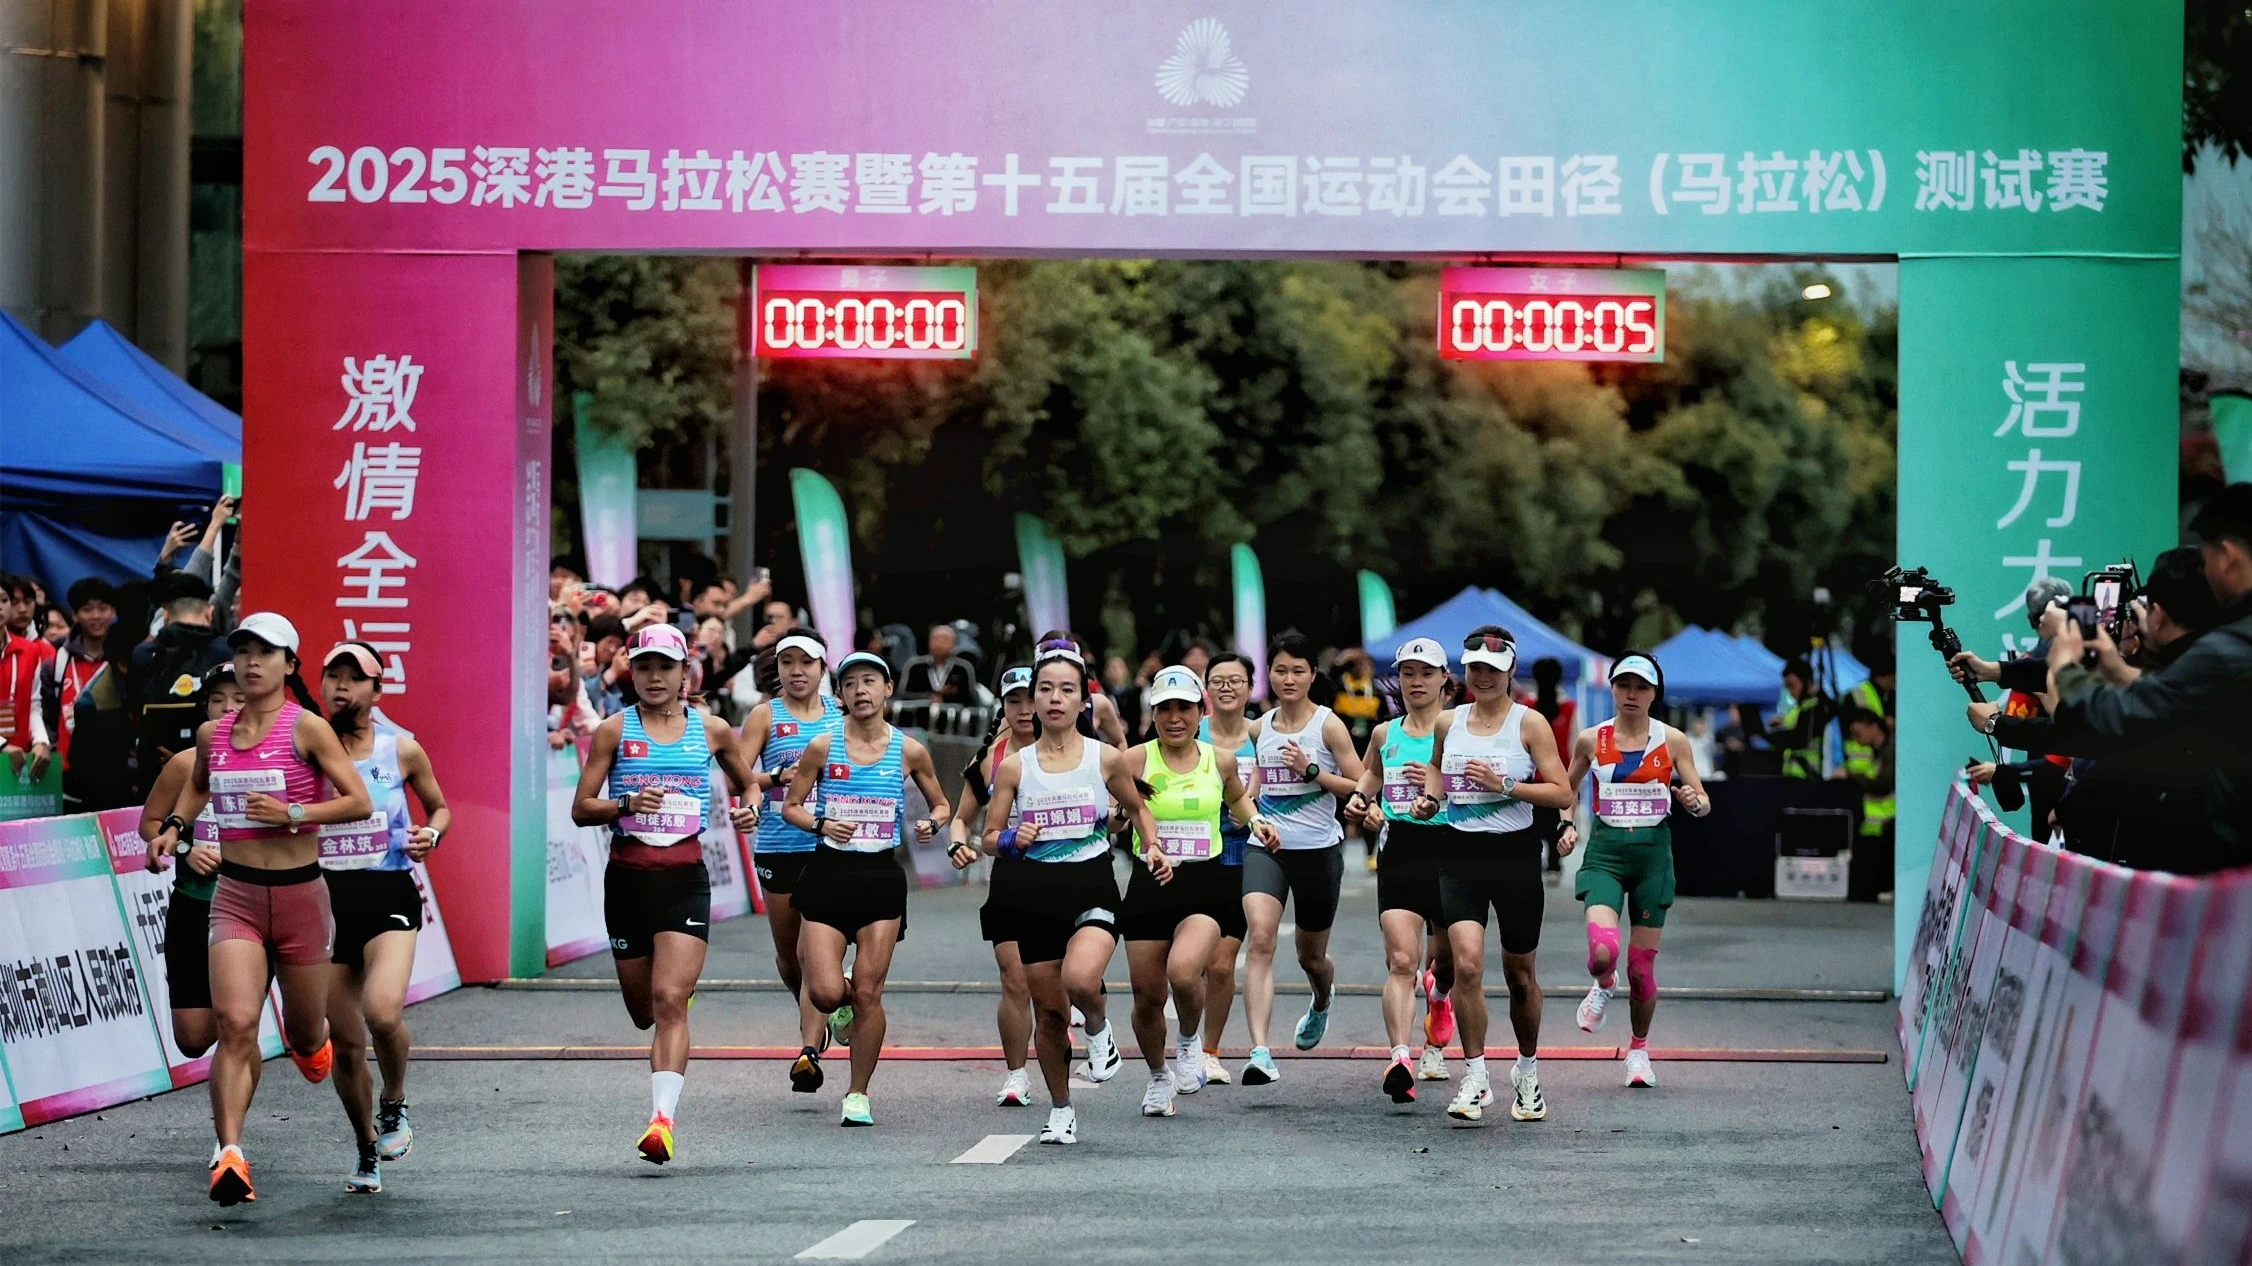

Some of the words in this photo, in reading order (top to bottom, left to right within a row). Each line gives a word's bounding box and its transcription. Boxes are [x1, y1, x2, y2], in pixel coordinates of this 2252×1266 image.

[1529, 272, 1577, 292] 女子
[765, 298, 965, 350] 00:00:00
[1452, 300, 1655, 353] 00:00:05
[1993, 360, 2086, 652] 活力大
[623, 774, 660, 786] HONG
[663, 774, 702, 787] KONG
[1391, 786, 1425, 800] 李素
[1033, 807, 1082, 826] 田娟娟
[1611, 801, 1653, 815] 汤奕君
[321, 835, 374, 855] 金林筑
